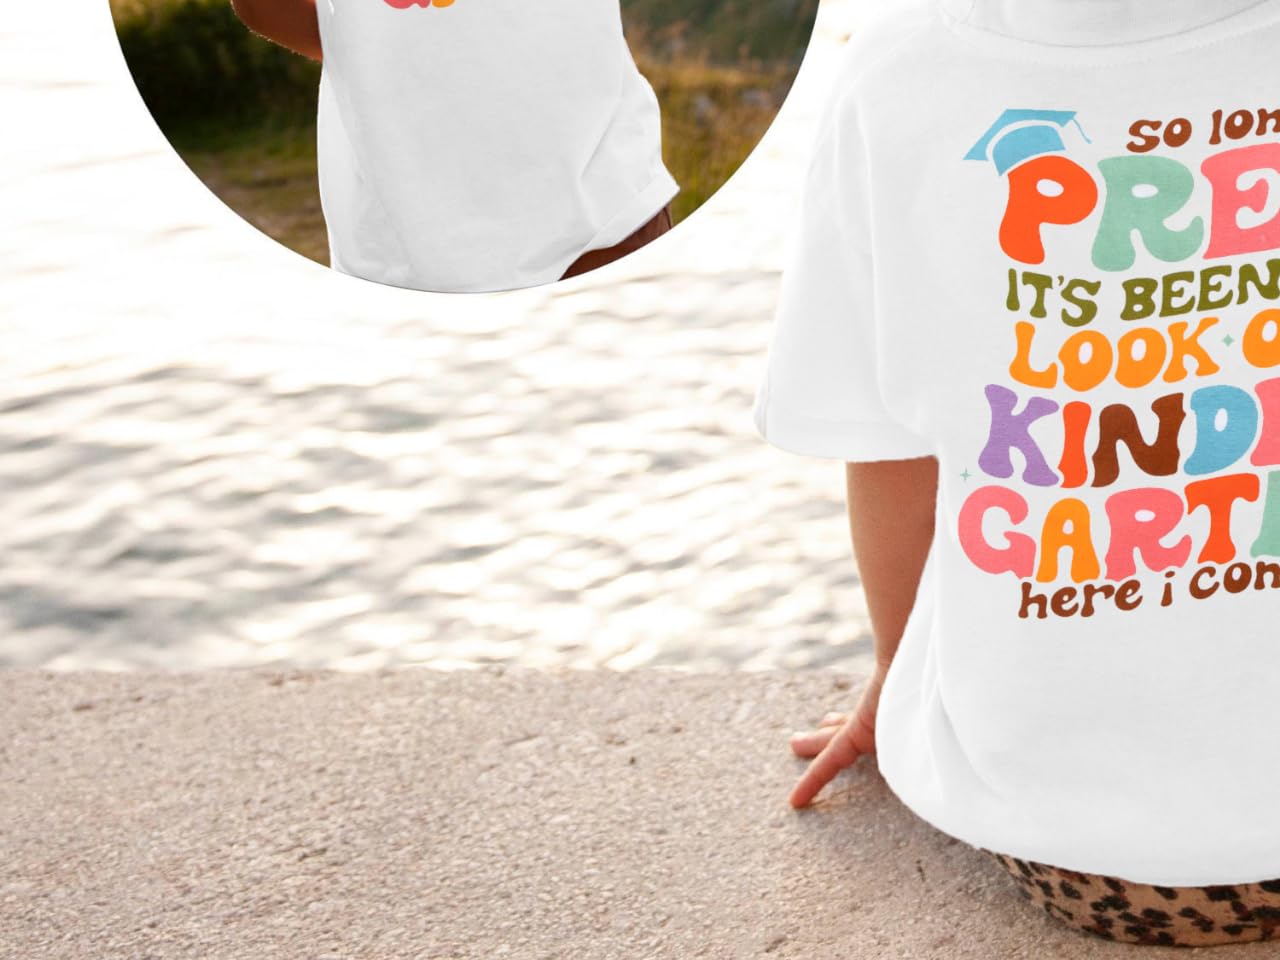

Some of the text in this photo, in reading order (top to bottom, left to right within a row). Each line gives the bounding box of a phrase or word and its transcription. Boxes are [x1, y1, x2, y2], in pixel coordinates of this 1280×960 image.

[1126, 117, 1192, 153] so
[1005, 268, 1101, 328] IT'S
[1008, 316, 1220, 392] LOOK
[1018, 578, 1143, 620] here
[1160, 570, 1174, 607] i
